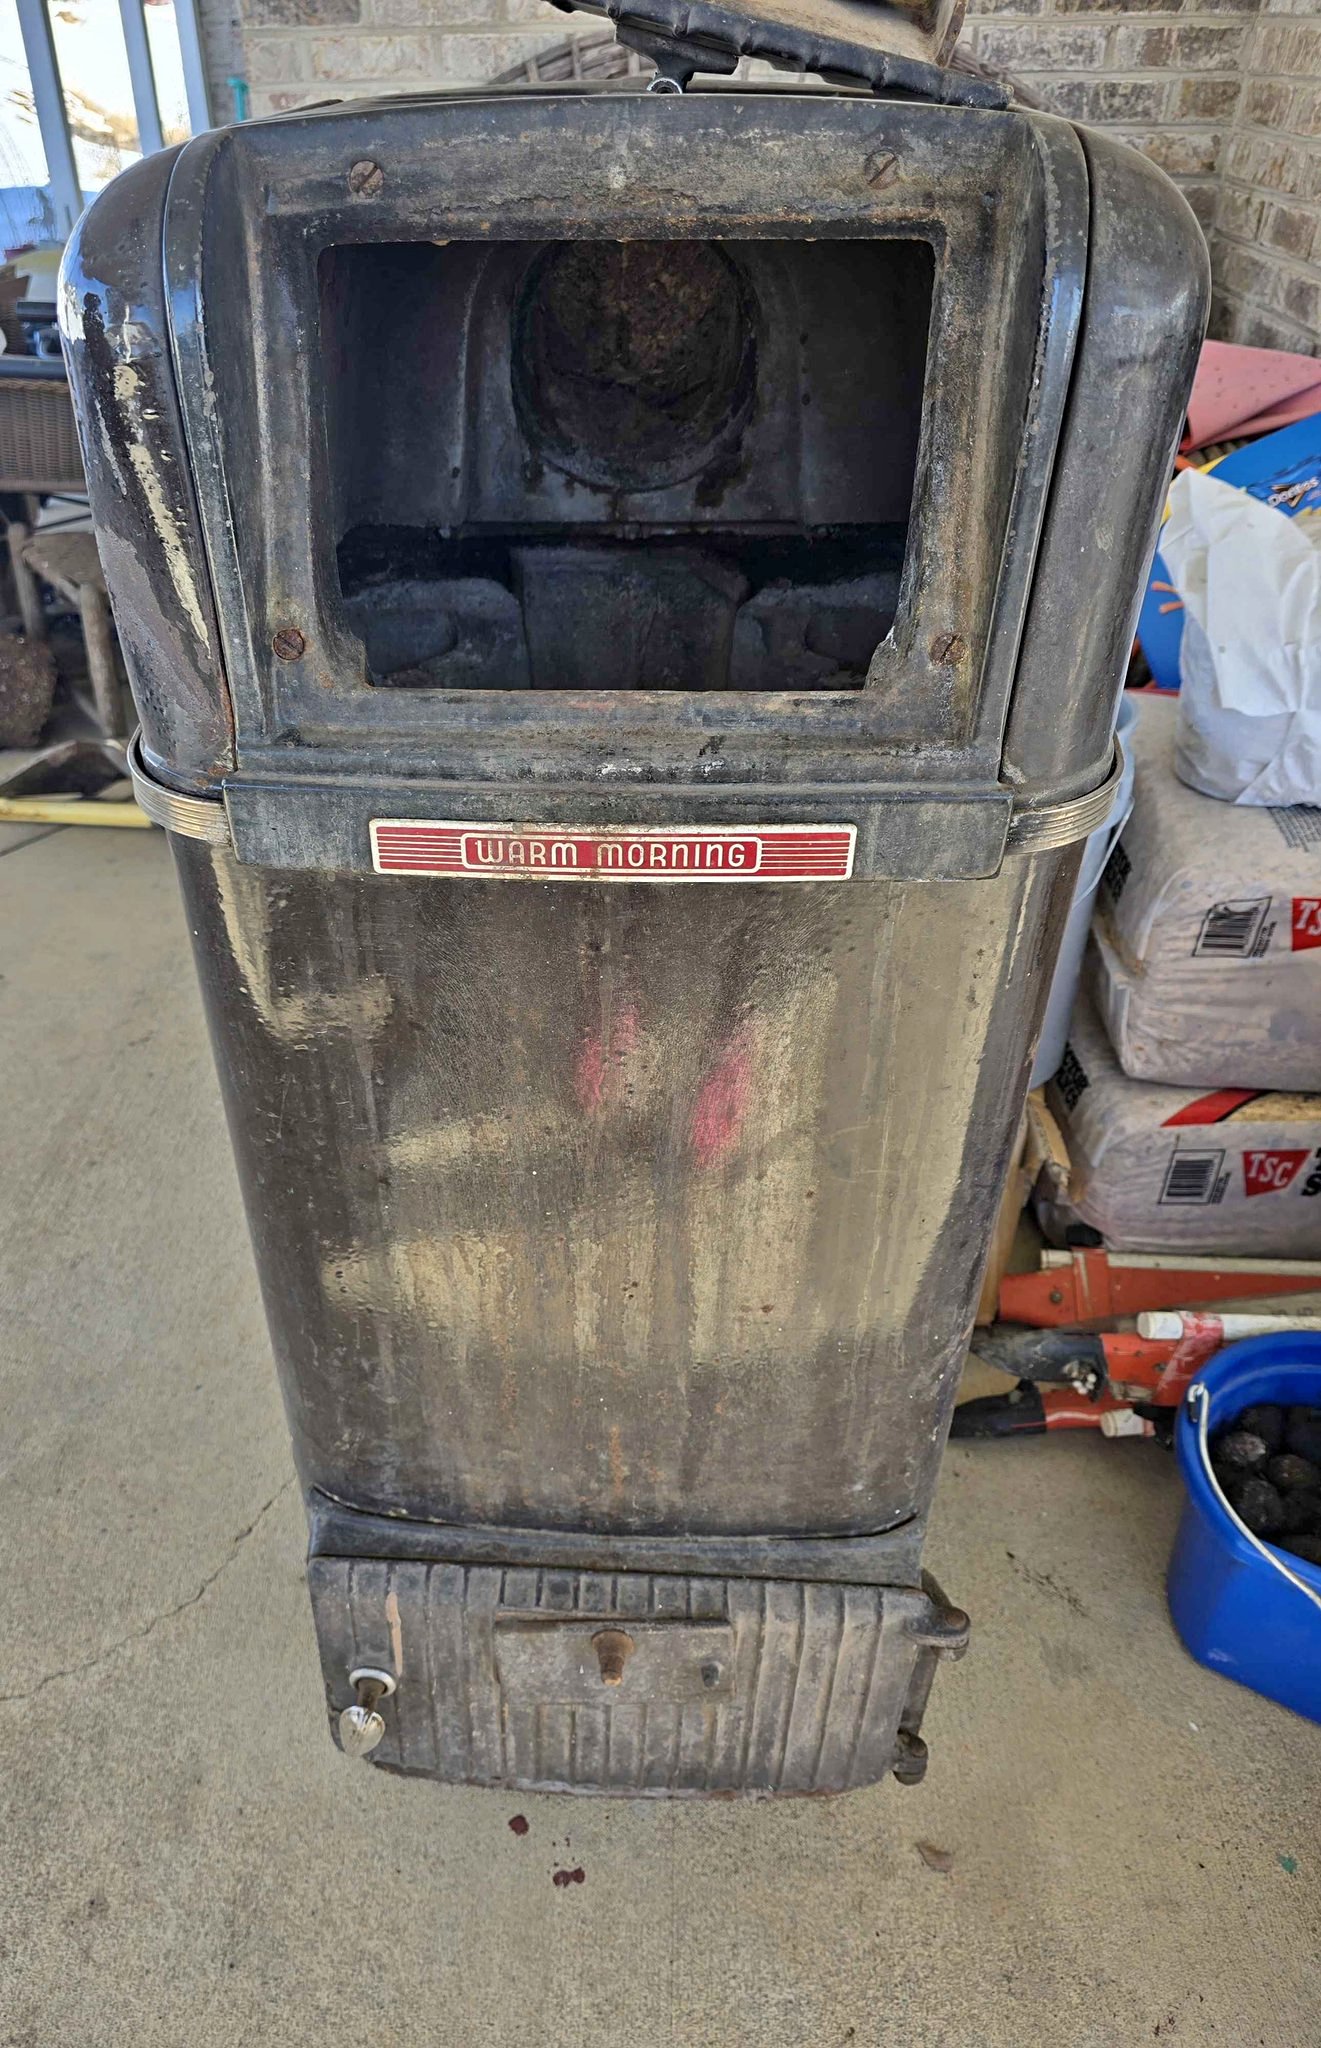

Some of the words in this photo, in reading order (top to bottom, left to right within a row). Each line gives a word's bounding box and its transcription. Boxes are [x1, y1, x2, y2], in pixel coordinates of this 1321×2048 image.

[475, 840, 577, 866] WARM
[597, 843, 745, 867] MORNING
[1250, 1153, 1293, 1186] TSC
